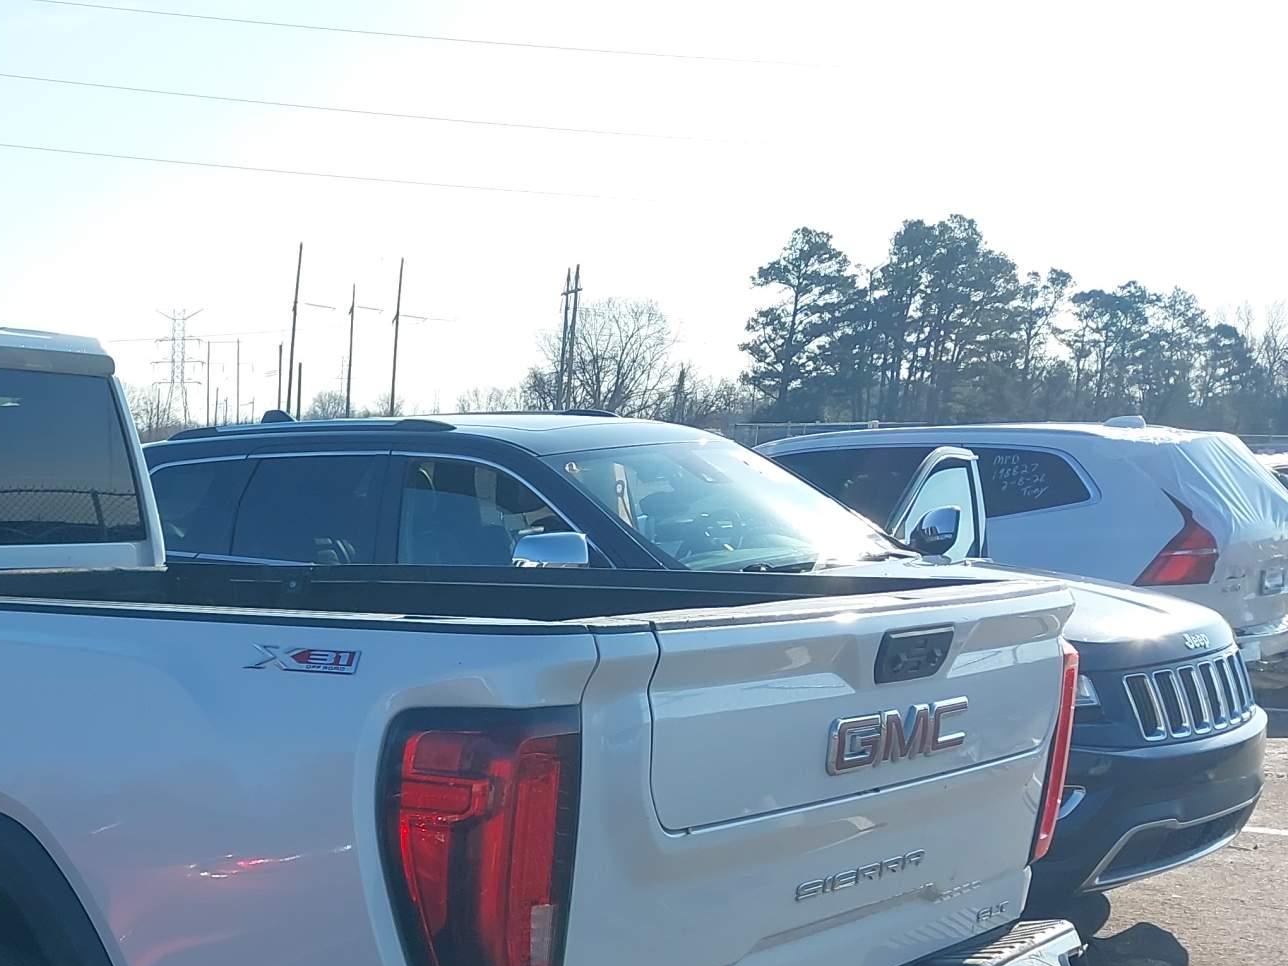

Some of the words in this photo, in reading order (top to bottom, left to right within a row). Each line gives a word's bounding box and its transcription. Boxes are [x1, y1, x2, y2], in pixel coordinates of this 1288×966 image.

[1183, 632, 1210, 650] Jeep
[825, 695, 969, 776] GMC
[795, 848, 926, 901] SIERRA
